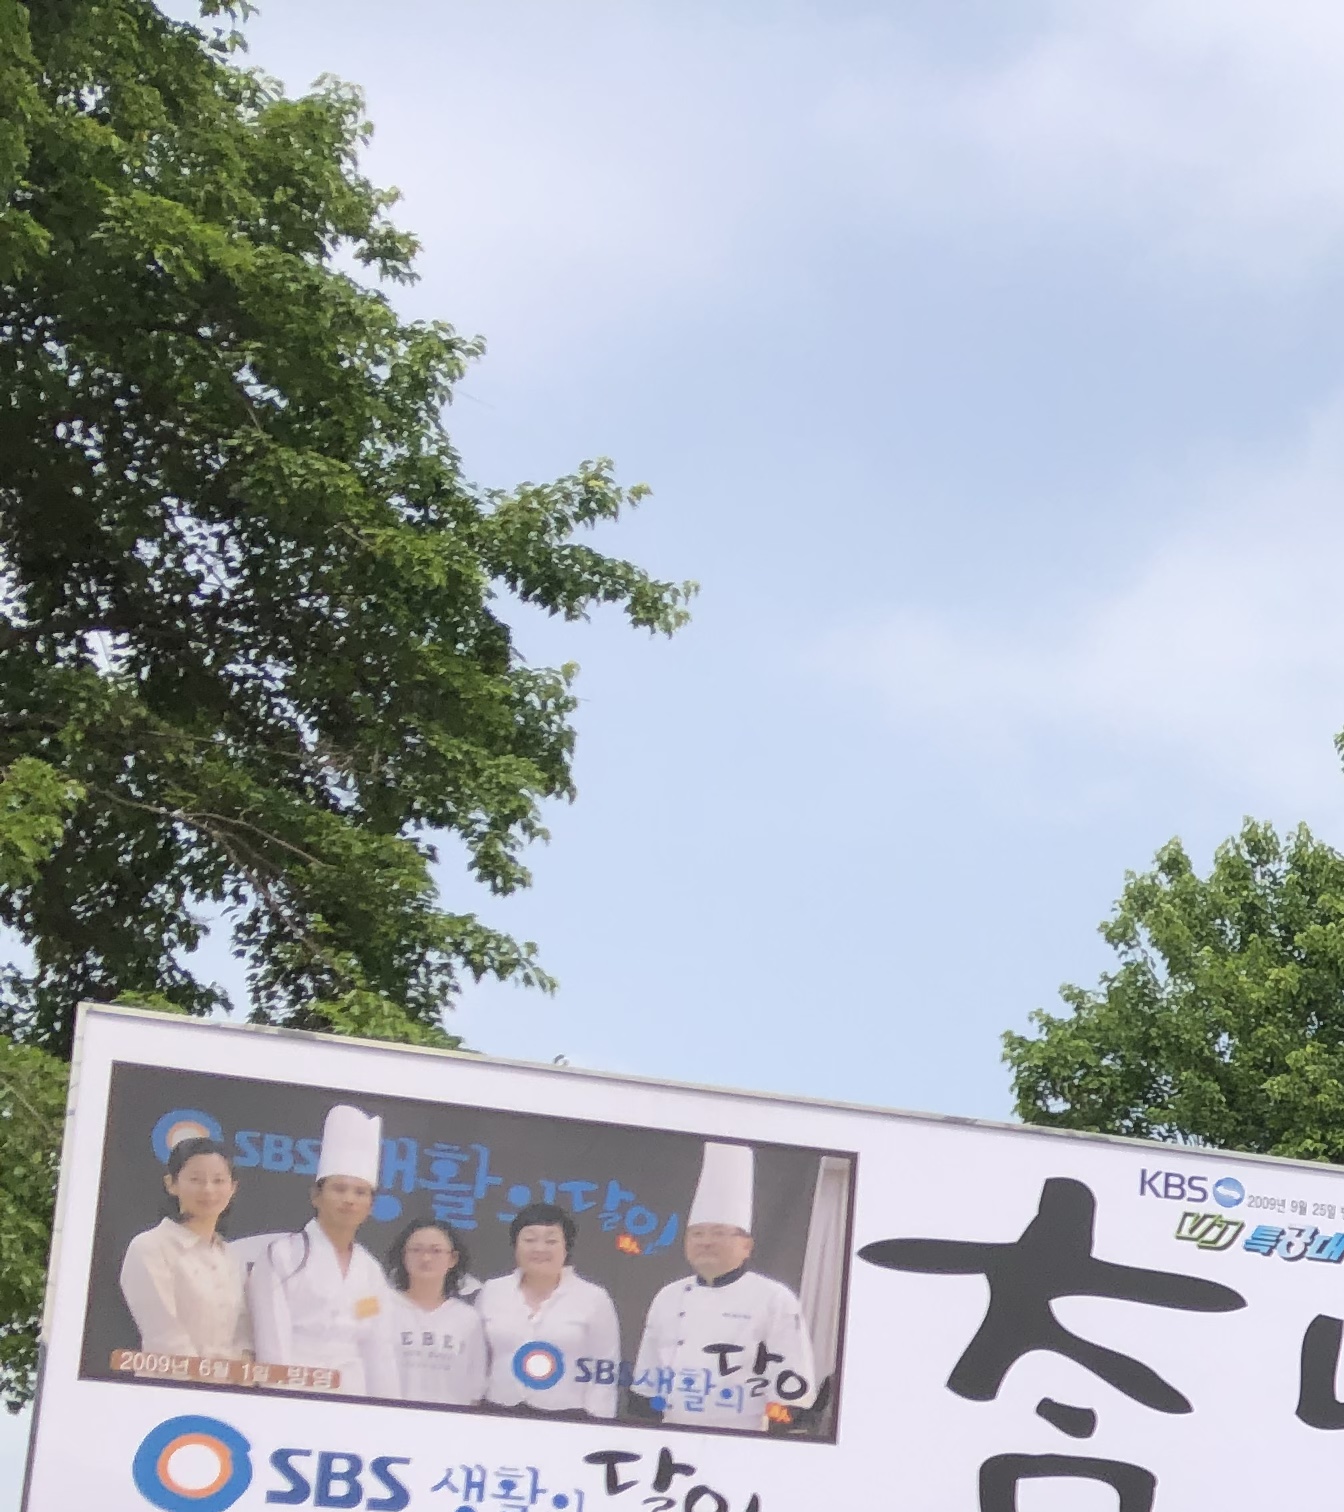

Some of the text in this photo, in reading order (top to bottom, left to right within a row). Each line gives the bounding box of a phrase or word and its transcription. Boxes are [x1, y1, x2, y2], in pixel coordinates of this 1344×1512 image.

[1140, 1168, 1209, 1203] KBS
[1247, 1195, 1286, 1213] 2009년
[1290, 1200, 1308, 1216] 9월
[1312, 1203, 1336, 1220] 25일
[1175, 1211, 1245, 1252] VJ
[120, 1351, 190, 1376] 2009년
[199, 1358, 230, 1379] 6월
[265, 1447, 413, 1512] SBS
